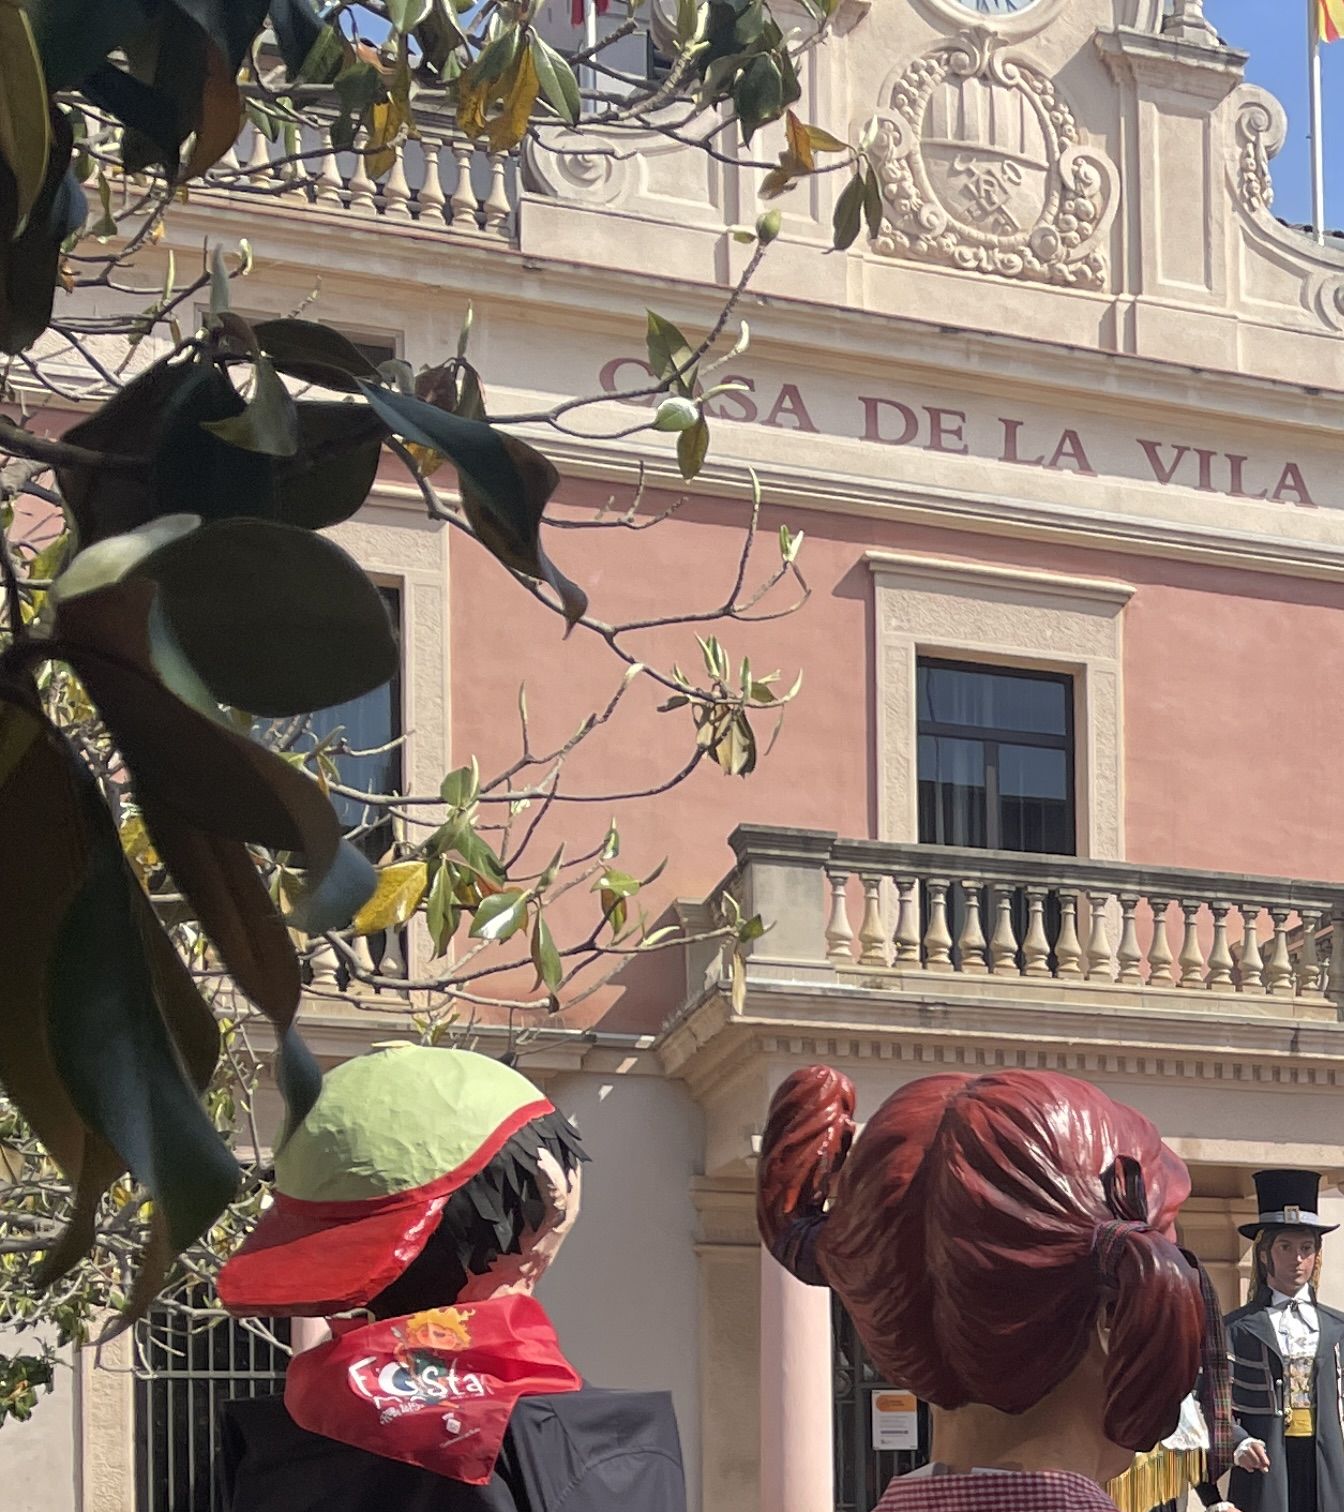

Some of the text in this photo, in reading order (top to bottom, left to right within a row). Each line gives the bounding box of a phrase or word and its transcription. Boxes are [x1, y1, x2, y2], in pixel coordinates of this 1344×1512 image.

[599, 357, 1319, 509] CSA DE LA VILA
